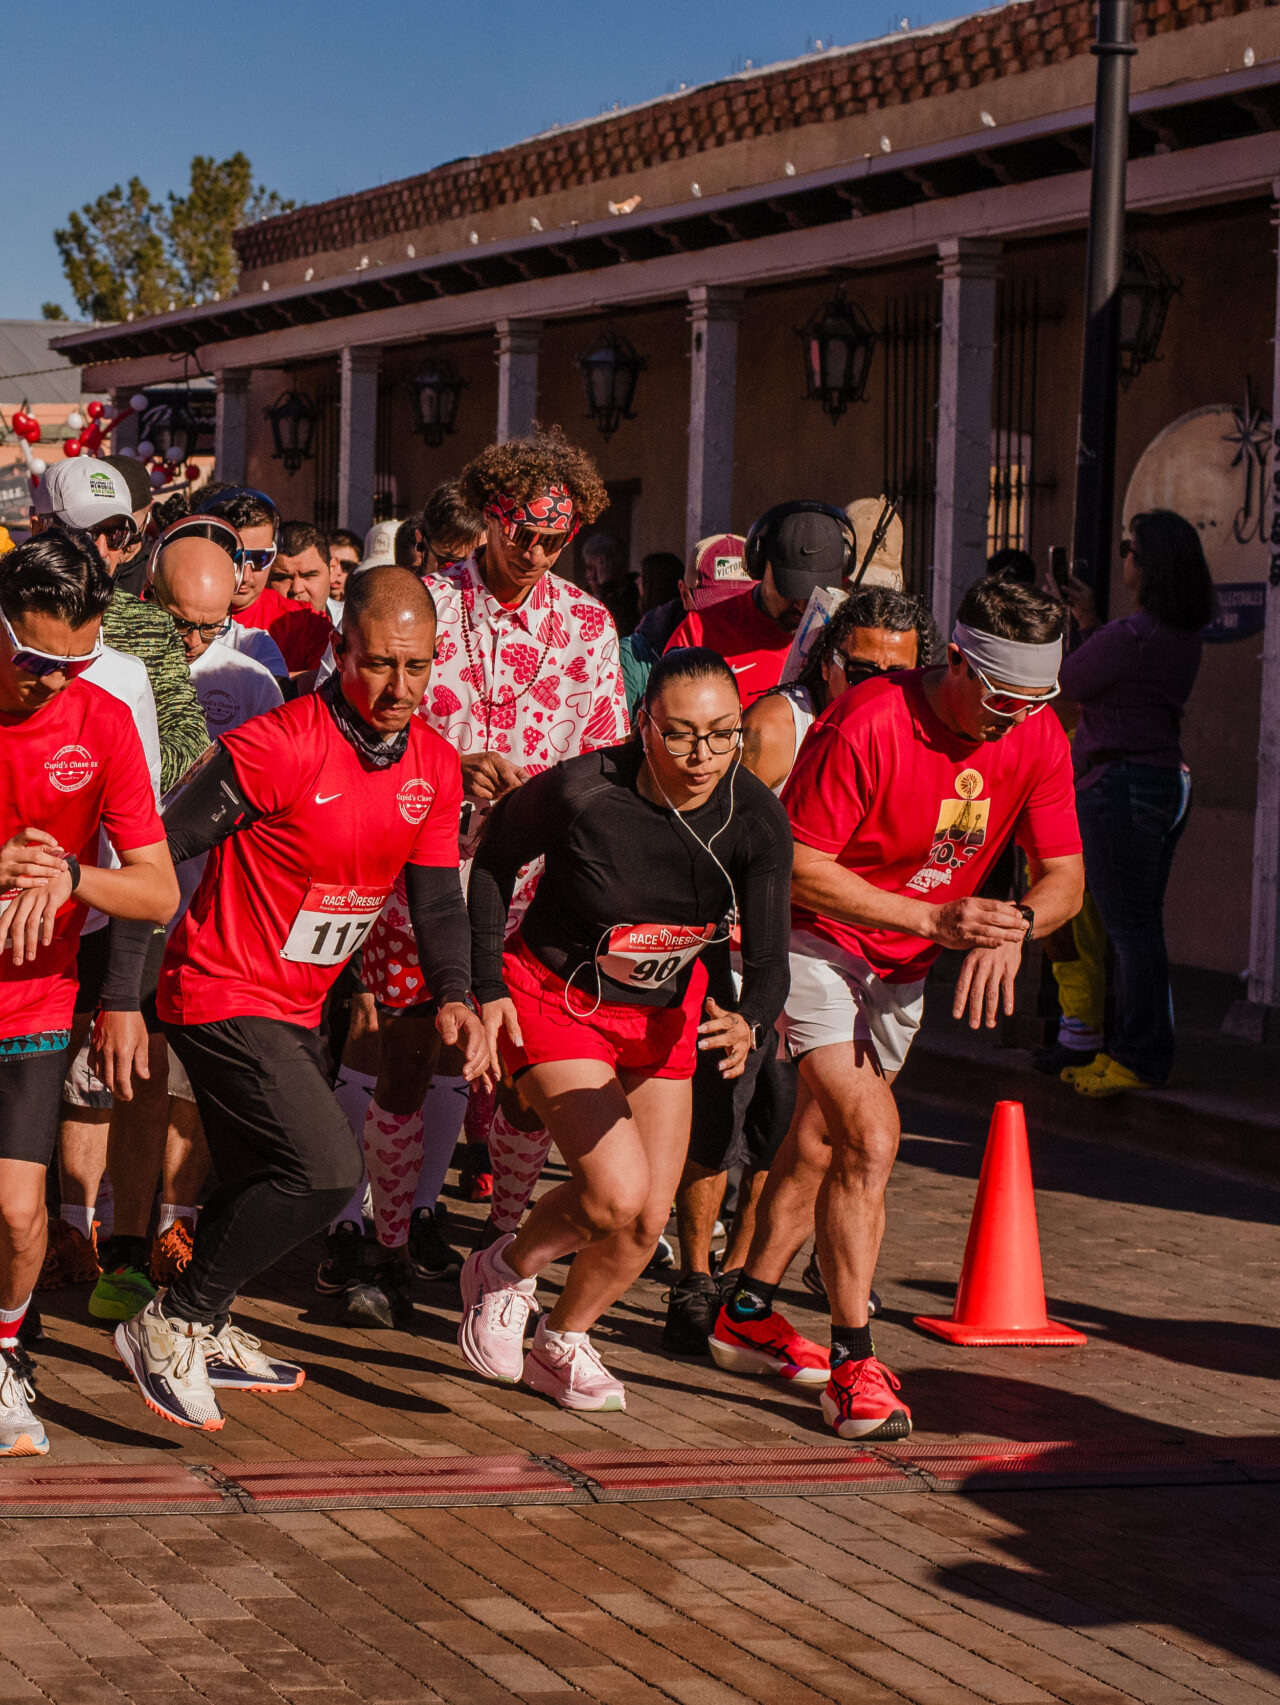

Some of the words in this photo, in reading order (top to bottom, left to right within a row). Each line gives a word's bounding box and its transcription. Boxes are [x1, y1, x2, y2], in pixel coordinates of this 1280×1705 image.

[44, 761, 68, 770] Cupid's
[69, 760, 89, 768] Chase
[322, 895, 347, 906] RACE
[356, 895, 386, 906] RESULT
[311, 920, 372, 956] 117
[629, 933, 658, 944] RACE
[672, 935, 704, 946] RESU
[629, 956, 682, 982] 90
